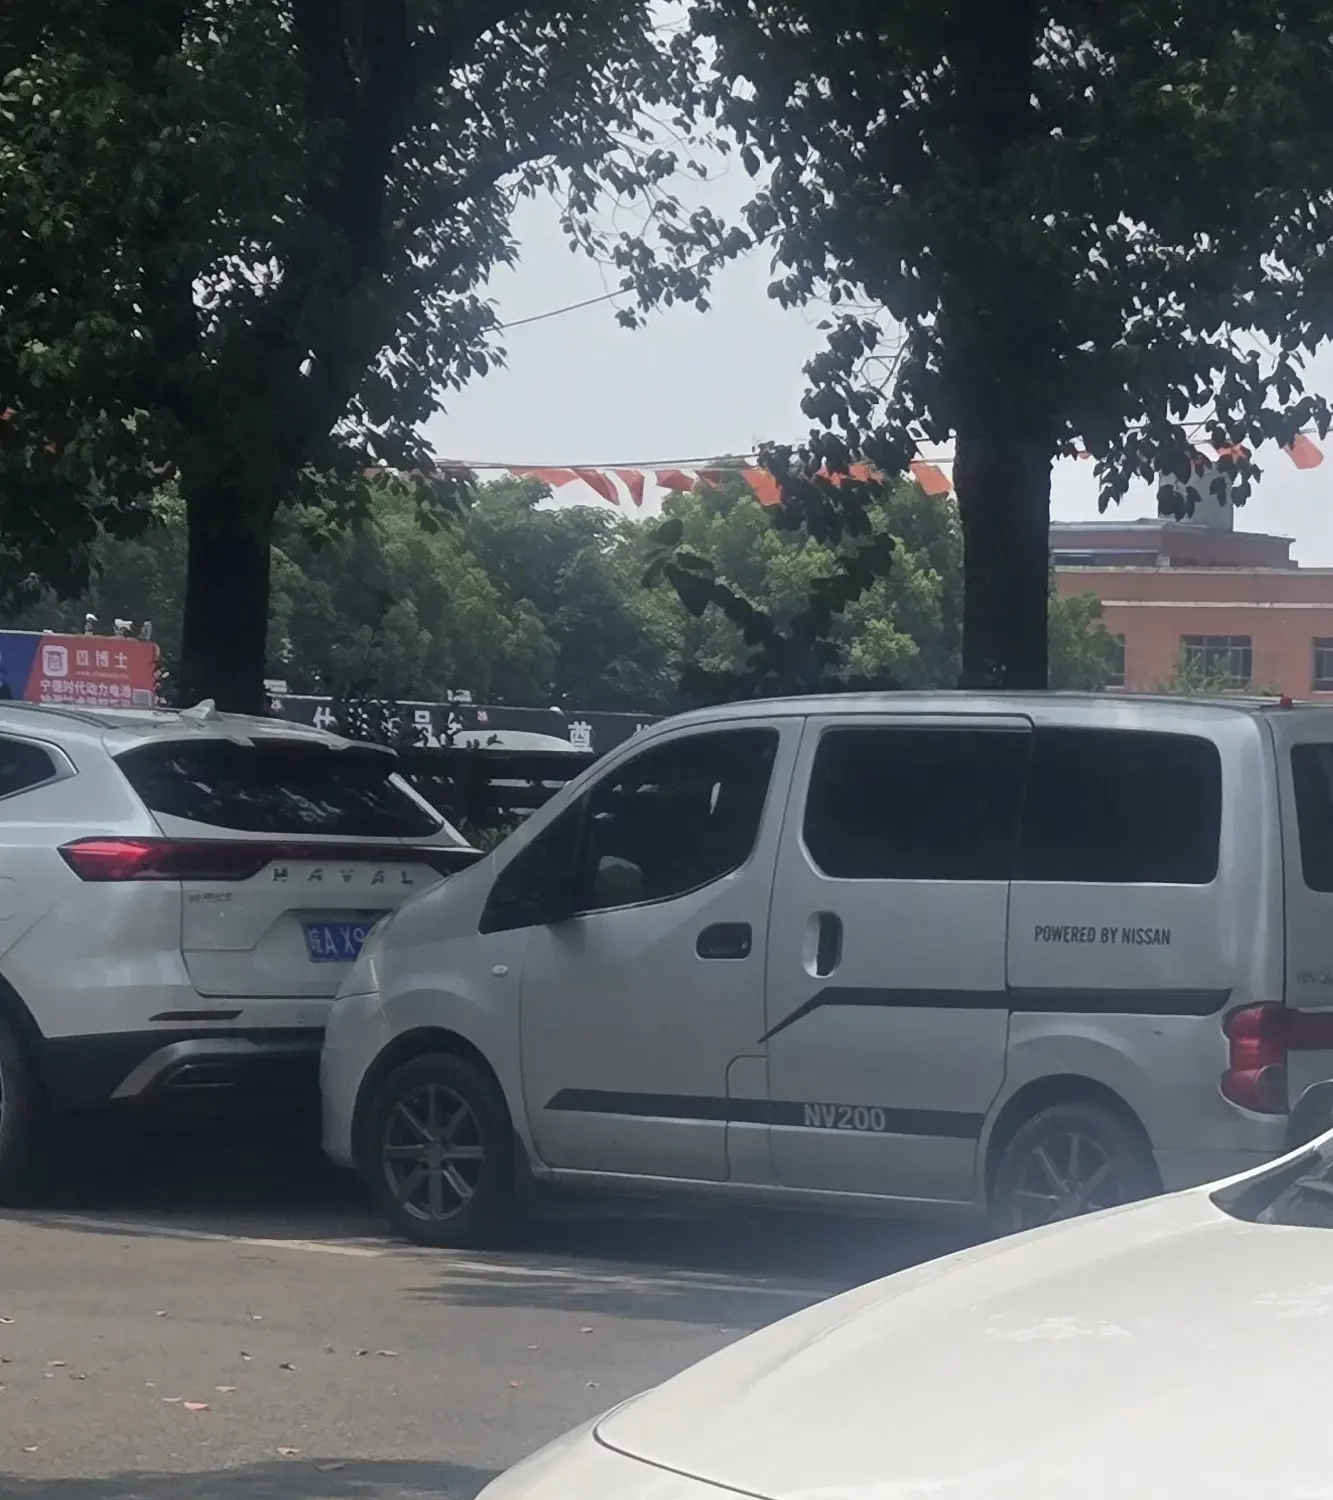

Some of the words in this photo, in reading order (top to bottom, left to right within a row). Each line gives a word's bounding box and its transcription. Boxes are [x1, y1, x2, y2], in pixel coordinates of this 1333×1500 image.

[272, 867, 414, 885] HAVAL
[1034, 924, 1097, 944] POWERED
[1100, 926, 1119, 944] BY
[1121, 927, 1172, 945] NISSAN
[803, 1103, 887, 1132] NV200
